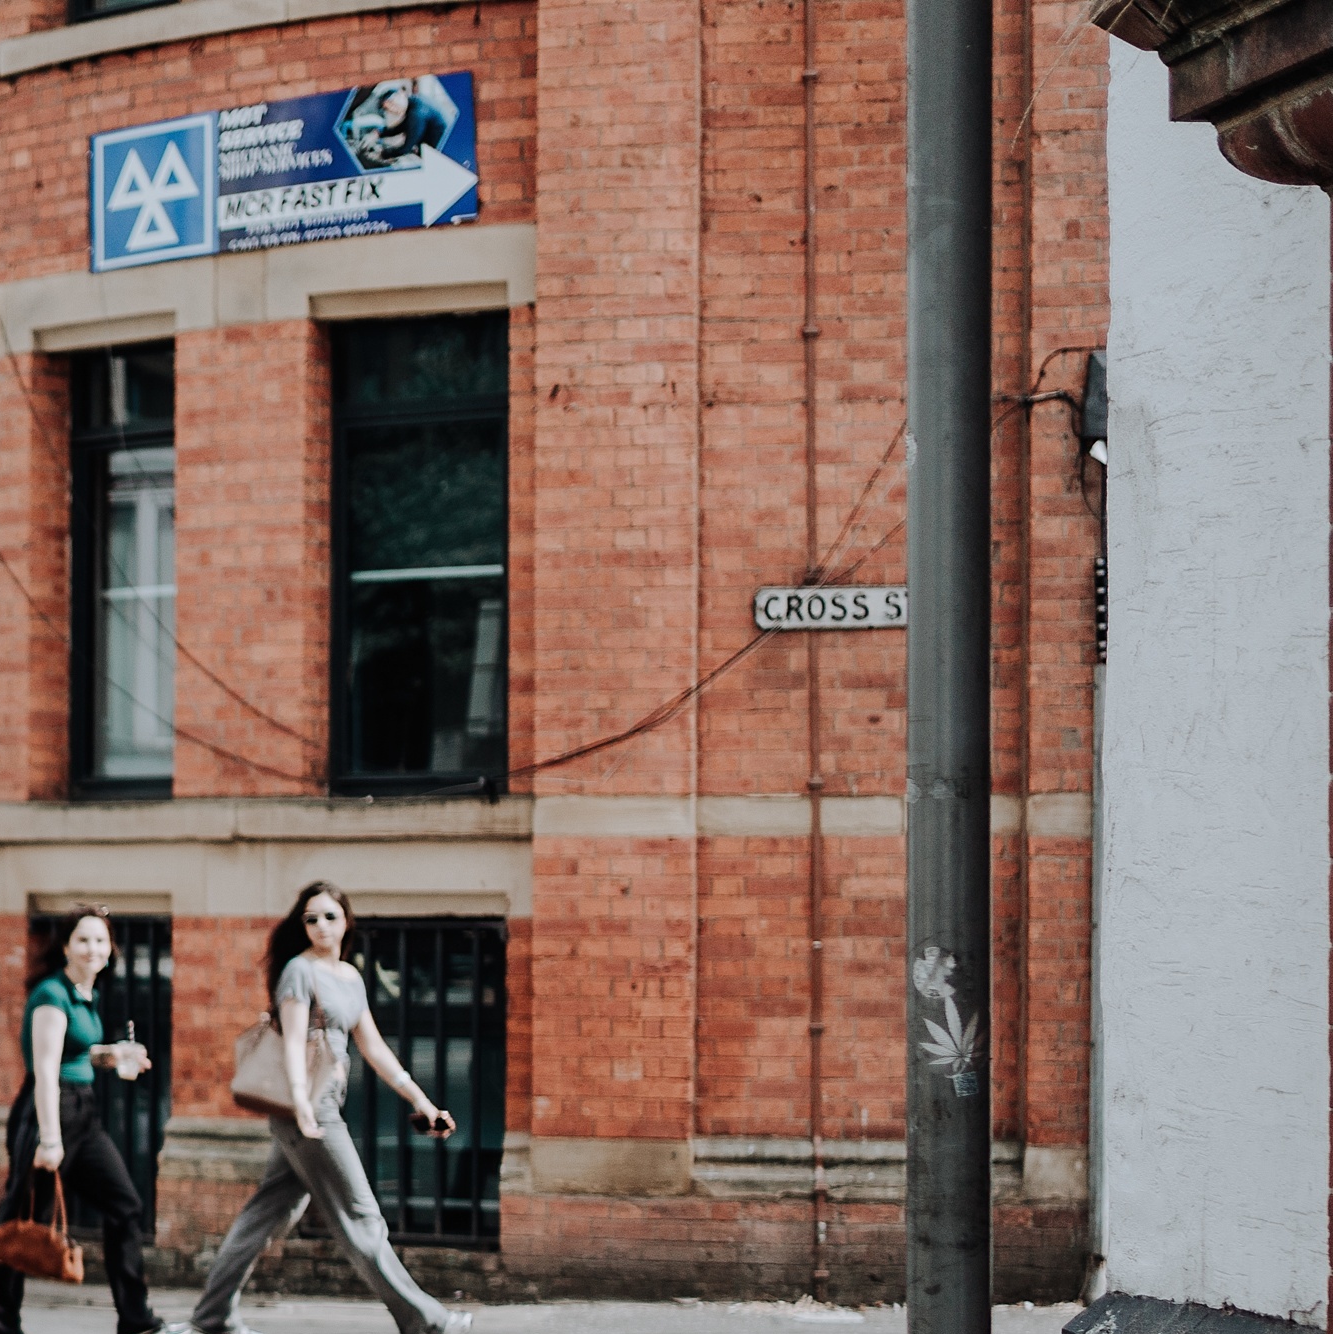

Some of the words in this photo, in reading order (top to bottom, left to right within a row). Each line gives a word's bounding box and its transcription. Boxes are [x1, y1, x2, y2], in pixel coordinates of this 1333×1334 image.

[225, 193, 271, 221] MCR
[280, 183, 337, 210] FAST
[344, 178, 383, 204] FIX
[763, 593, 870, 622] CROSS
[884, 592, 908, 621] S
